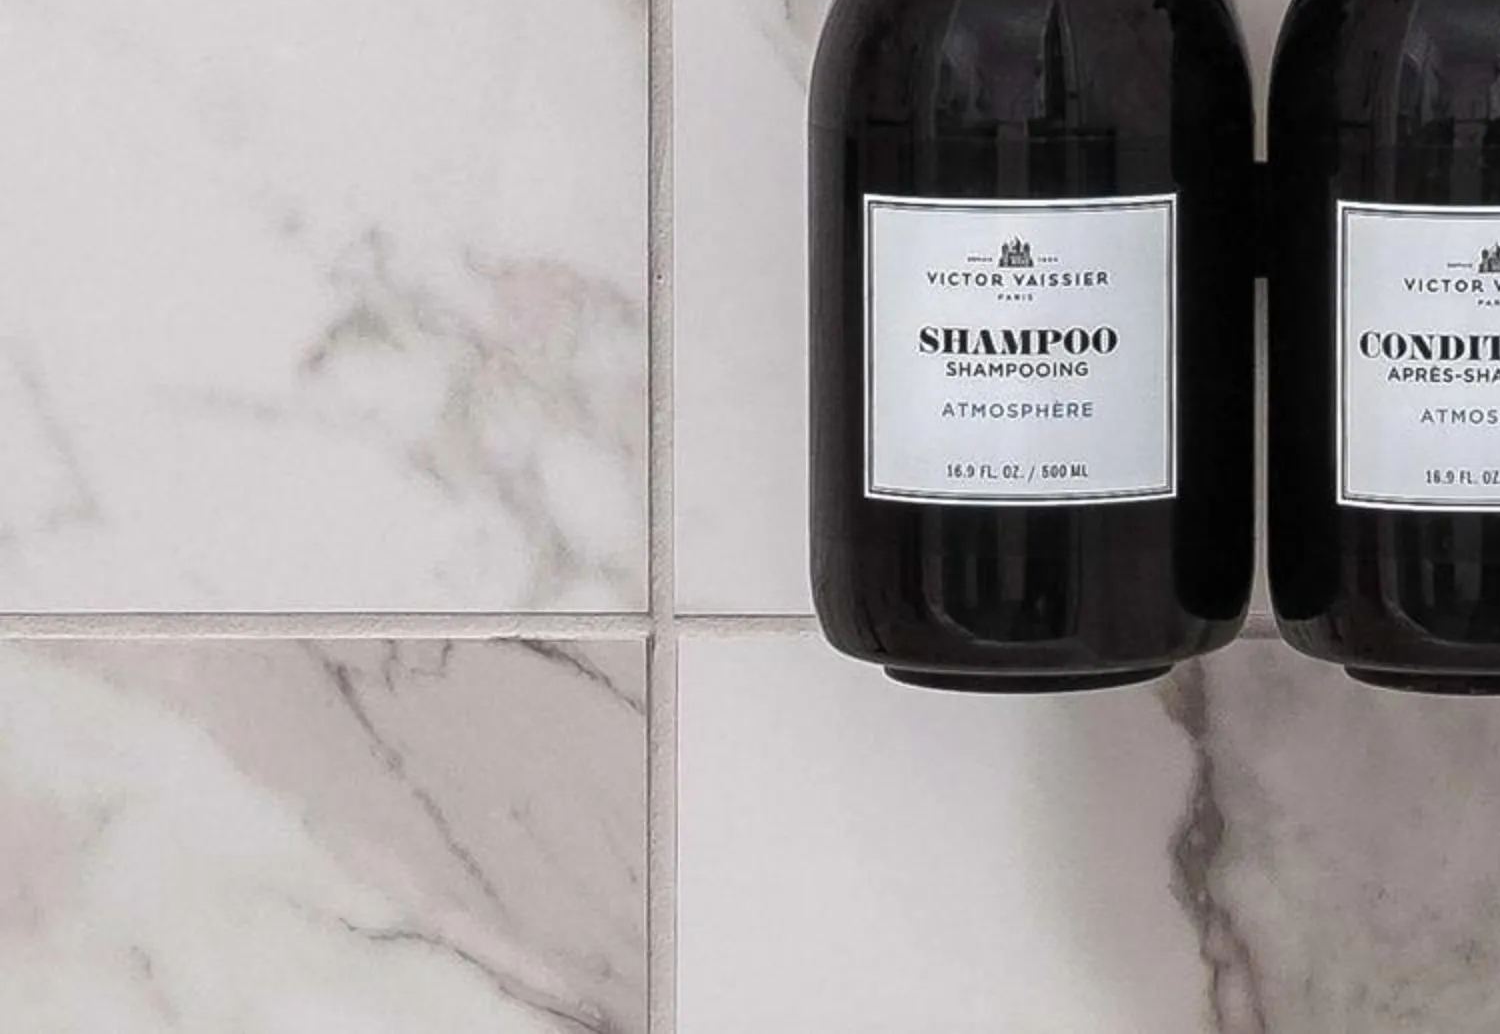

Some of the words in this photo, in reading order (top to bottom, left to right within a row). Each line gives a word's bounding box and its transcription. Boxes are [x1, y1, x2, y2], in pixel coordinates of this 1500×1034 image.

[926, 271, 1004, 287] VICTOR
[1012, 271, 1109, 287] VAISSIER
[1403, 277, 1485, 293] VICTOR
[918, 326, 1118, 355] SHAMPOO
[945, 361, 1089, 378] SHAMPOOING
[941, 401, 1093, 418] ATMOSPHÈRE
[947, 464, 975, 478] 16.9
[1027, 465, 1036, 483] /
[1070, 464, 1088, 477] ML
[1426, 469, 1455, 484] 16.9
